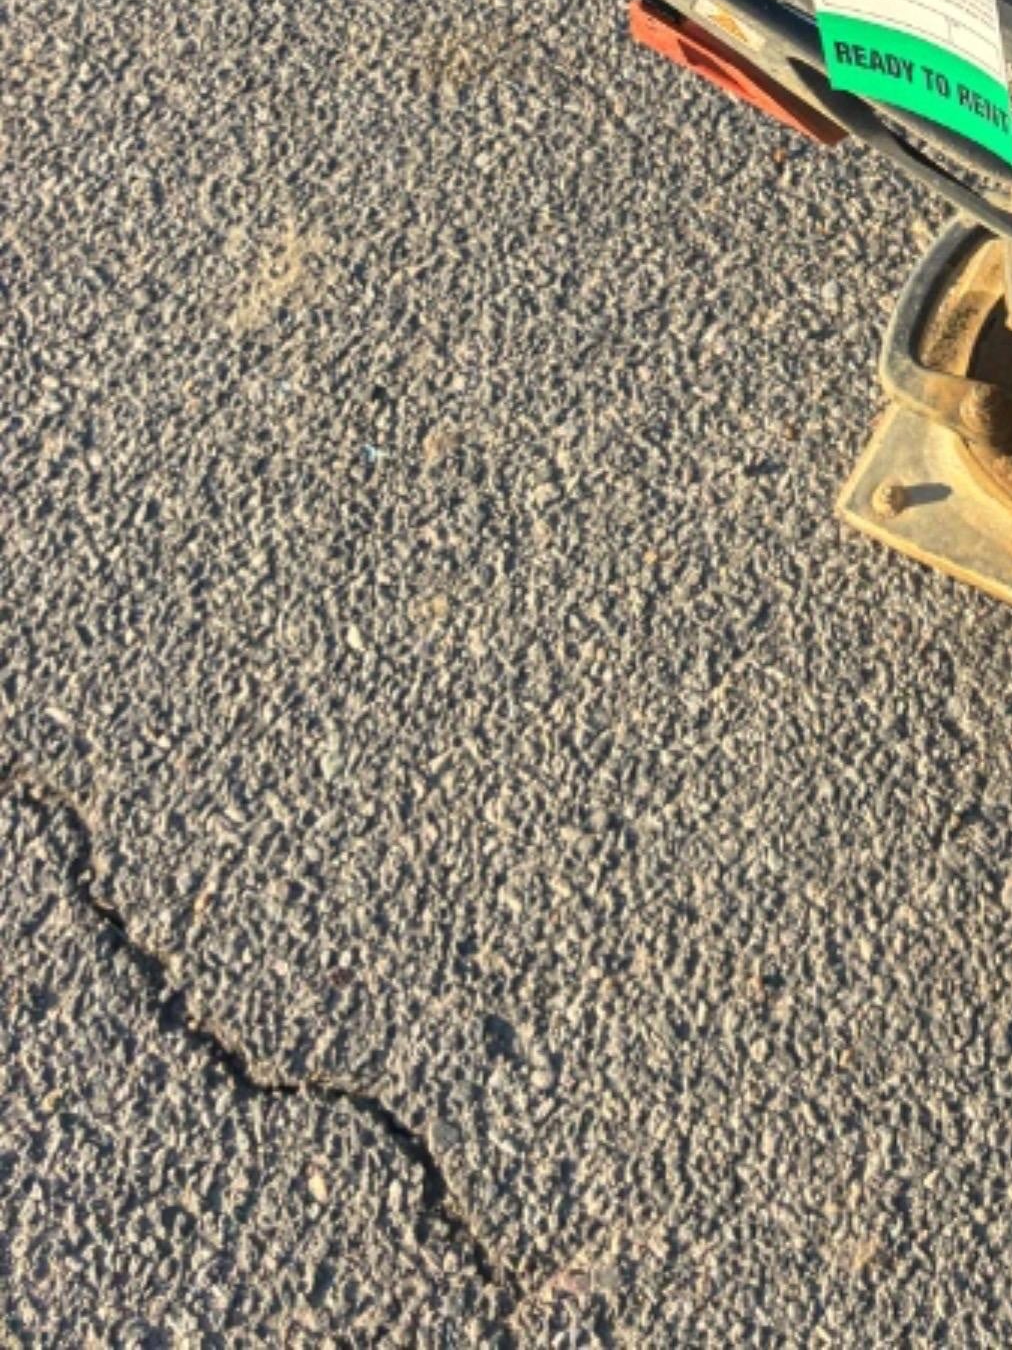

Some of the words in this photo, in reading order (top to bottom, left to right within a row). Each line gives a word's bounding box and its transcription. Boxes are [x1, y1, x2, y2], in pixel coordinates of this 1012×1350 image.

[834, 40, 916, 84] READY
[921, 65, 950, 100] TO
[956, 83, 1010, 134] RENT
